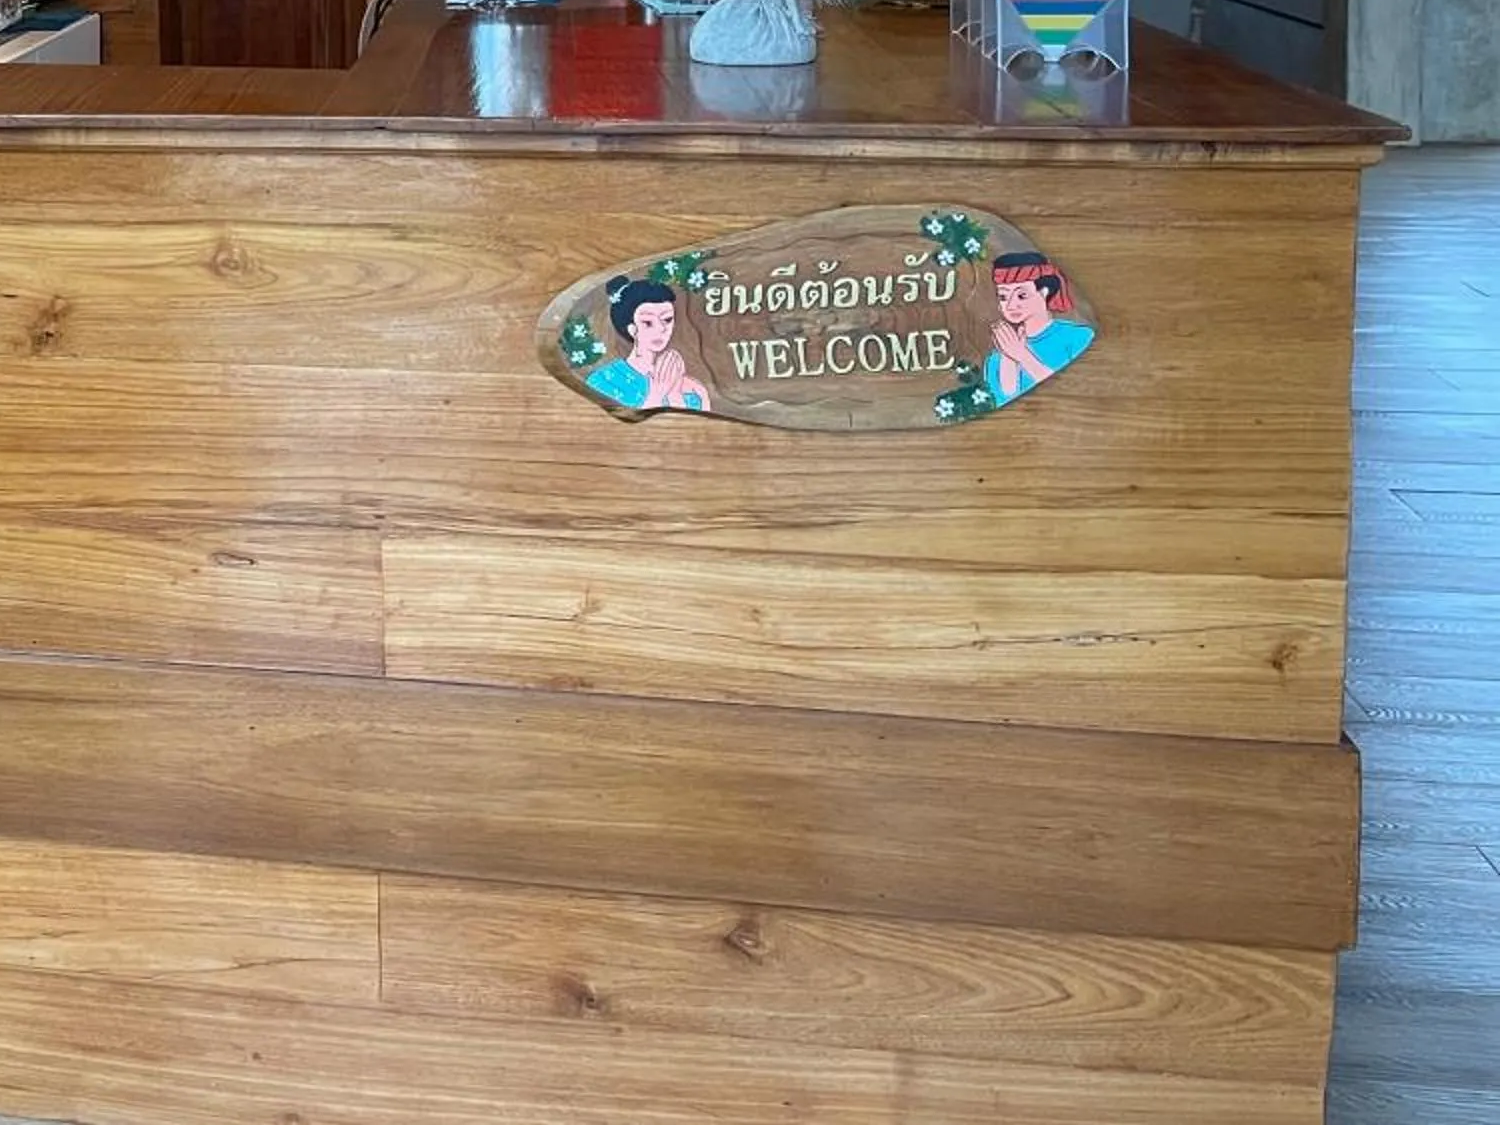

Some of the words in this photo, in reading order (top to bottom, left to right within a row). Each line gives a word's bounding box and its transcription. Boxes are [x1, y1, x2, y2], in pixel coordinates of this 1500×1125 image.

[704, 252, 956, 316] ยินดีต้อนรับ
[728, 329, 956, 379] WELCOME
